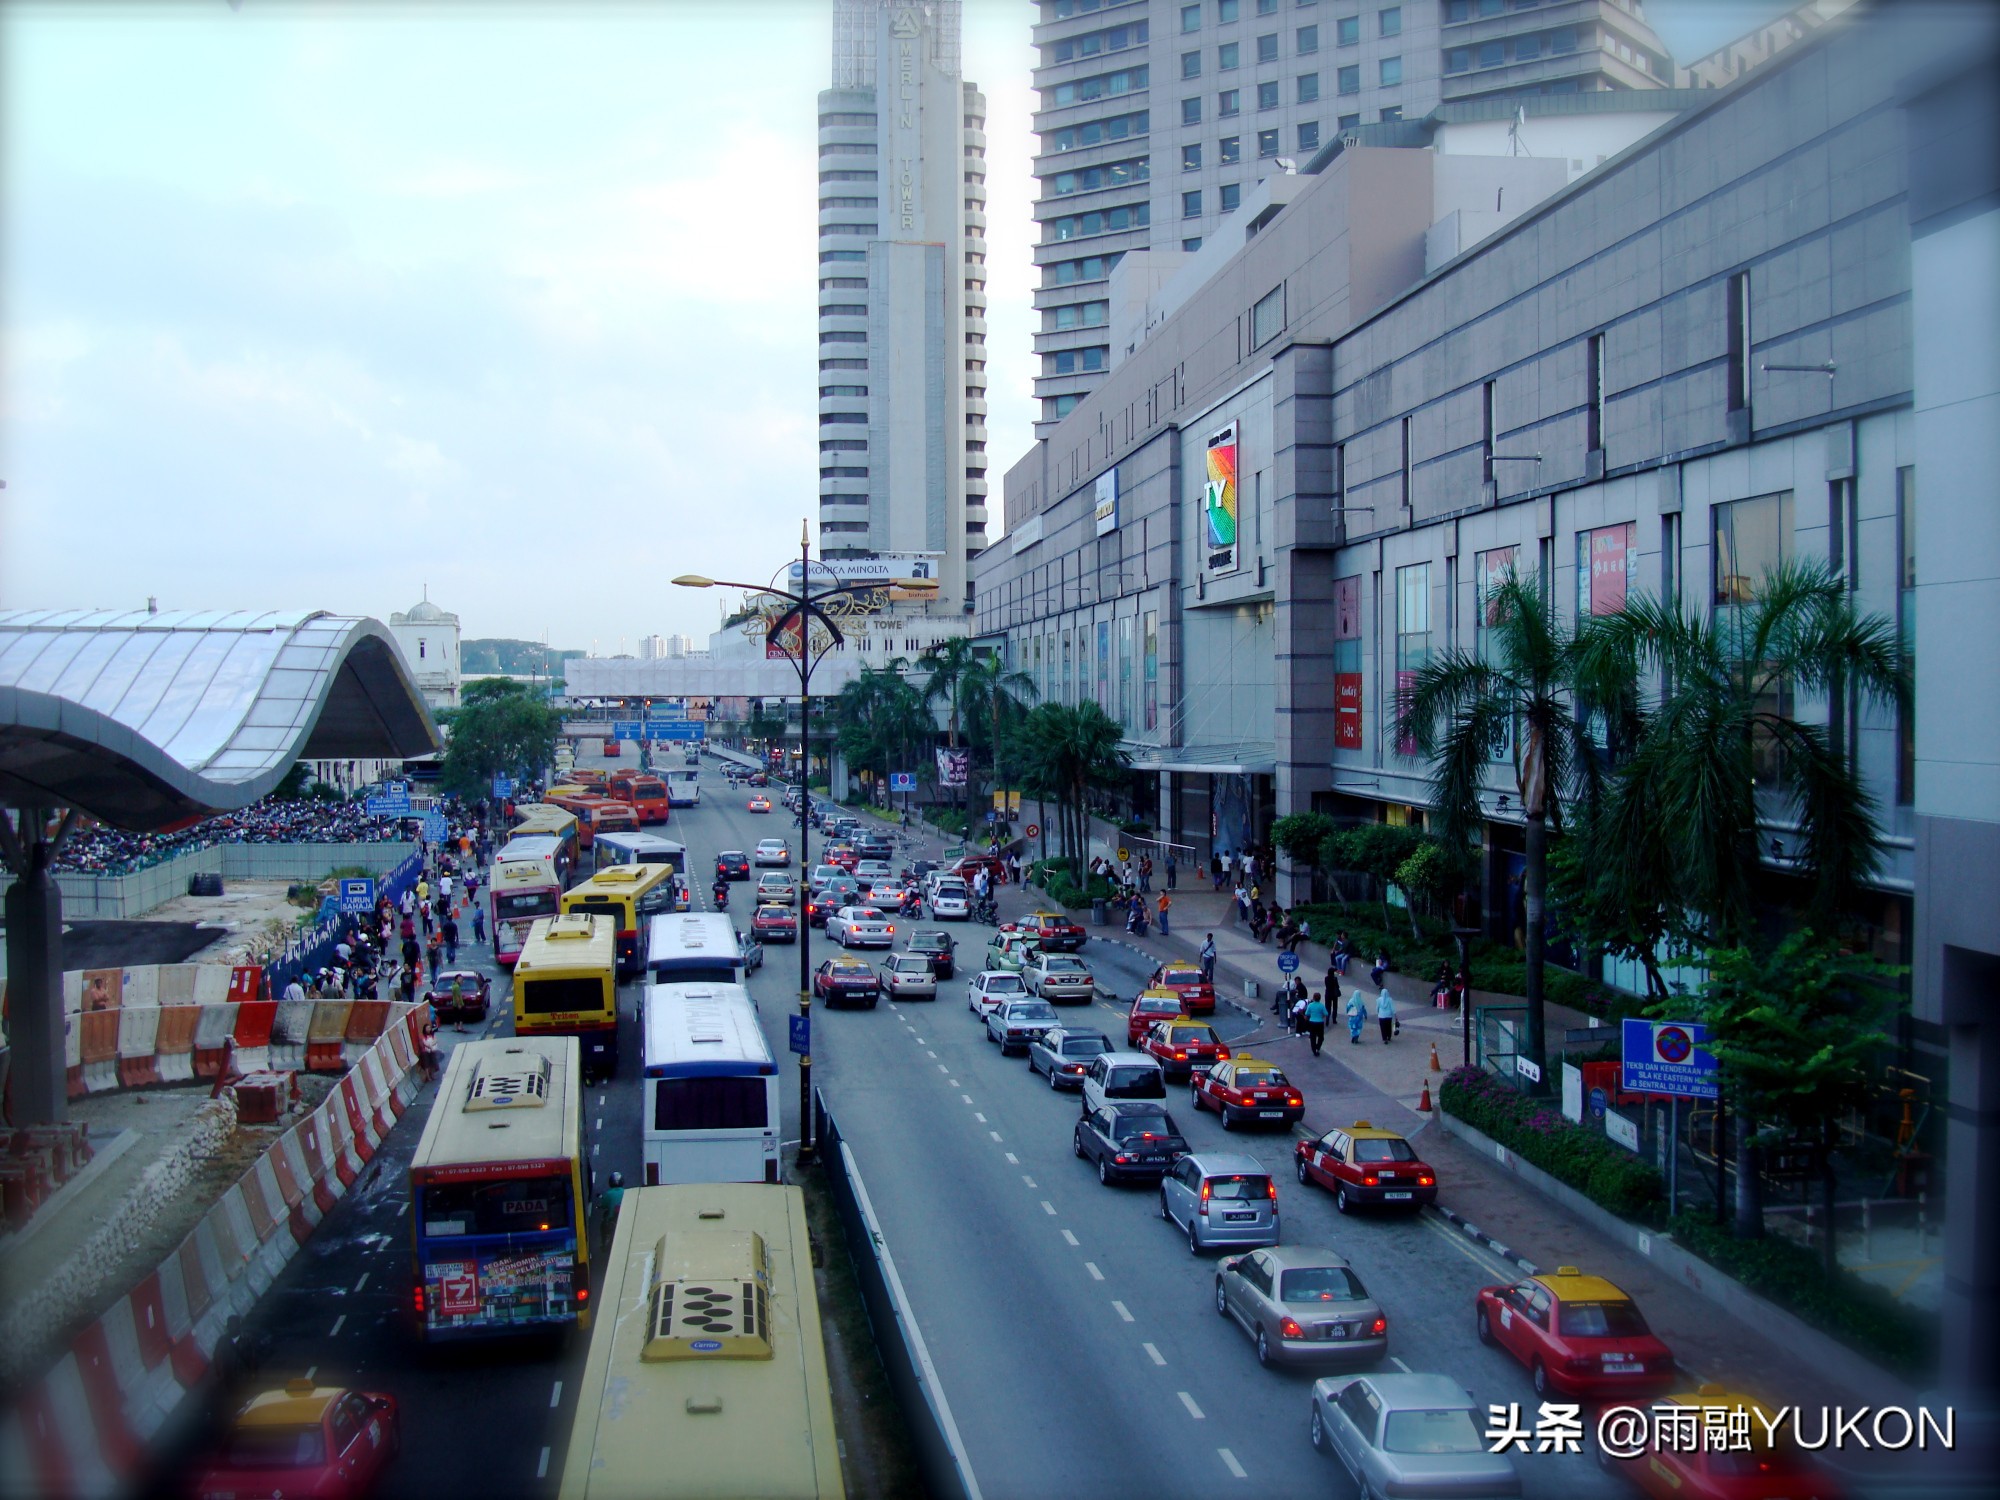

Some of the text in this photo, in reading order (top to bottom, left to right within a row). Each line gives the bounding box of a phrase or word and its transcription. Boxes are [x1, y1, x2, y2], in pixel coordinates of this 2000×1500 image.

[900, 42, 913, 229] MERLIN TOWER
[808, 565, 889, 575] KONICA MINOLTA
[1626, 1061, 1644, 1070] TEKSI
[1645, 1063, 1659, 1071] DAN
[1660, 1065, 1701, 1075] KENDERAAN
[1663, 1074, 1694, 1083] EASTERN
[1629, 1079, 1637, 1087] JB
[1638, 1080, 1667, 1090] SENTRAL
[506, 1200, 545, 1212] PADA
